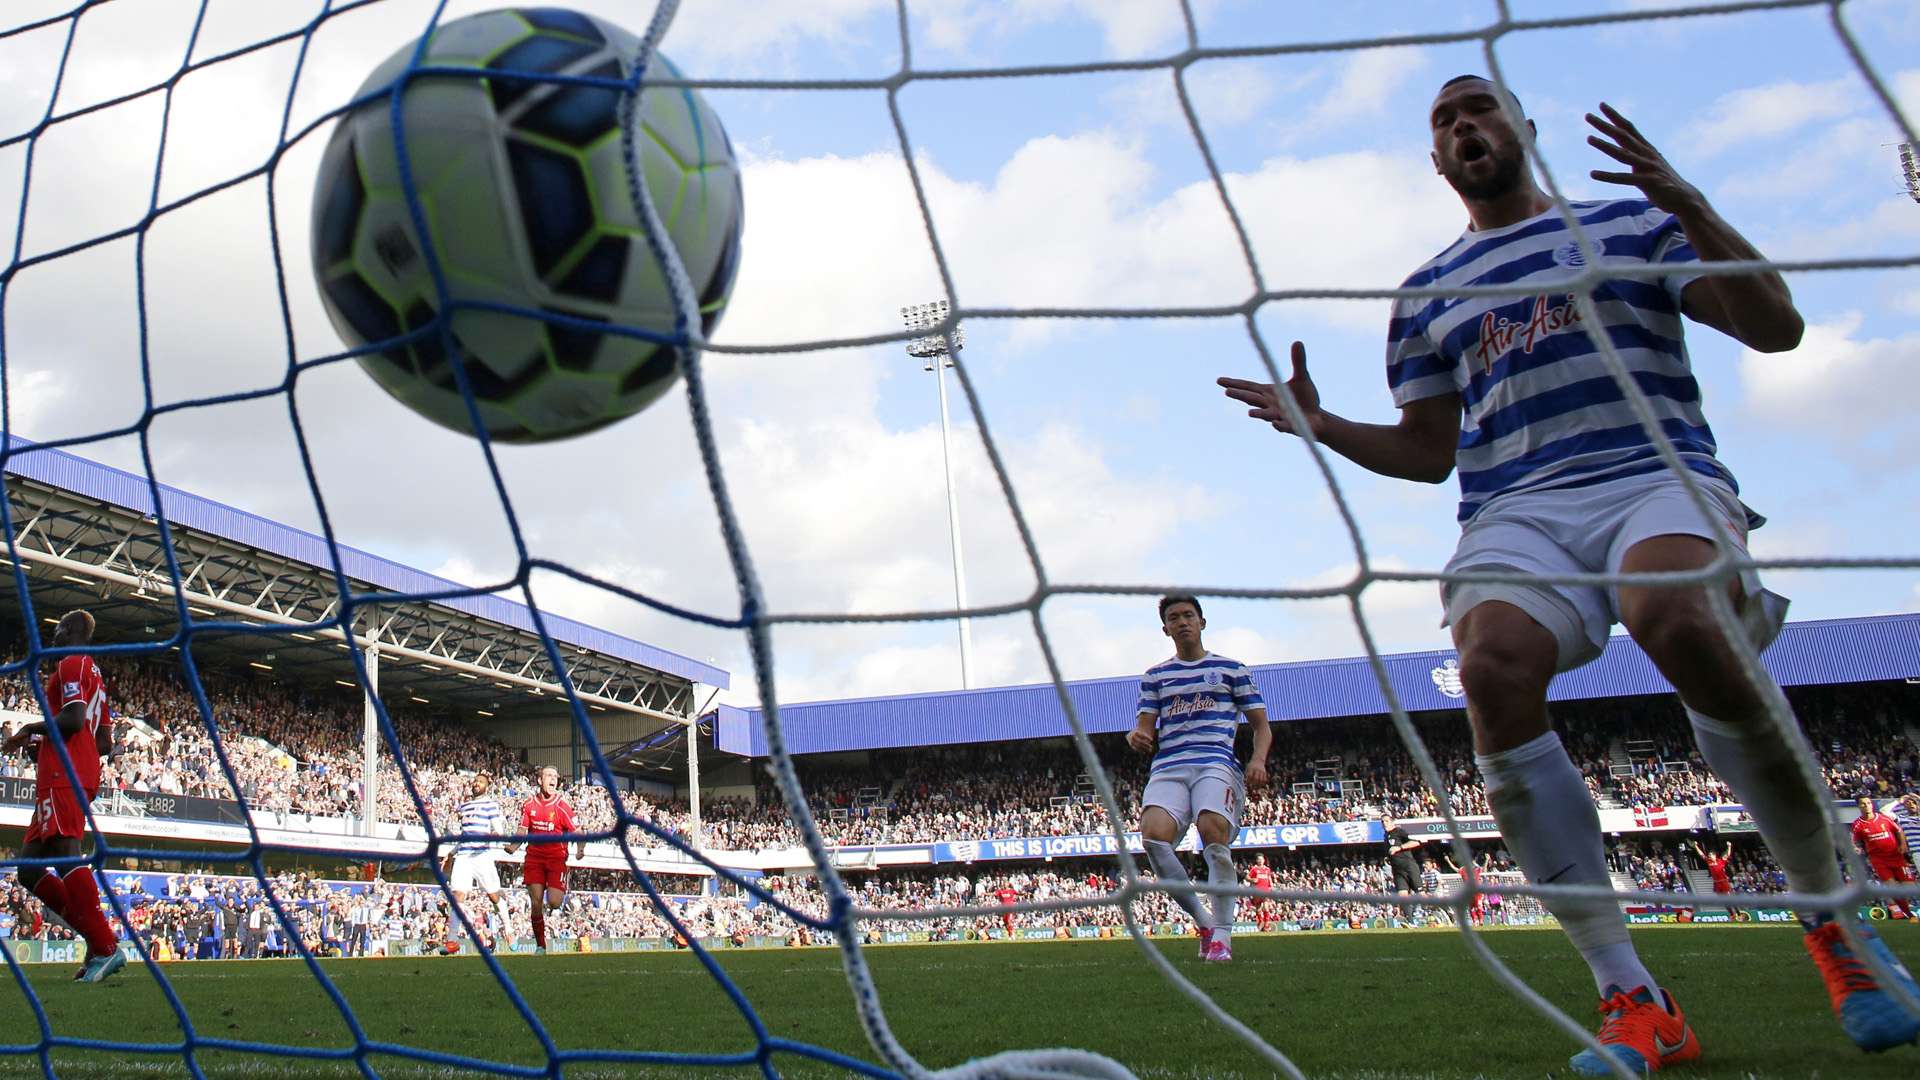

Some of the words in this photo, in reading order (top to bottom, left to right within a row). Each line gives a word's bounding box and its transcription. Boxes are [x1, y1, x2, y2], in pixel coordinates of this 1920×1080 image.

[1168, 692, 1216, 720] AirAsia
[150, 796, 176, 814] 1882
[1244, 828, 1277, 846] ARE
[1281, 825, 1321, 844] QPR
[1426, 823, 1449, 833] QPR
[992, 841, 1024, 857] THIS
[1028, 840, 1043, 856] IS
[1046, 836, 1102, 855] LOFTUS
